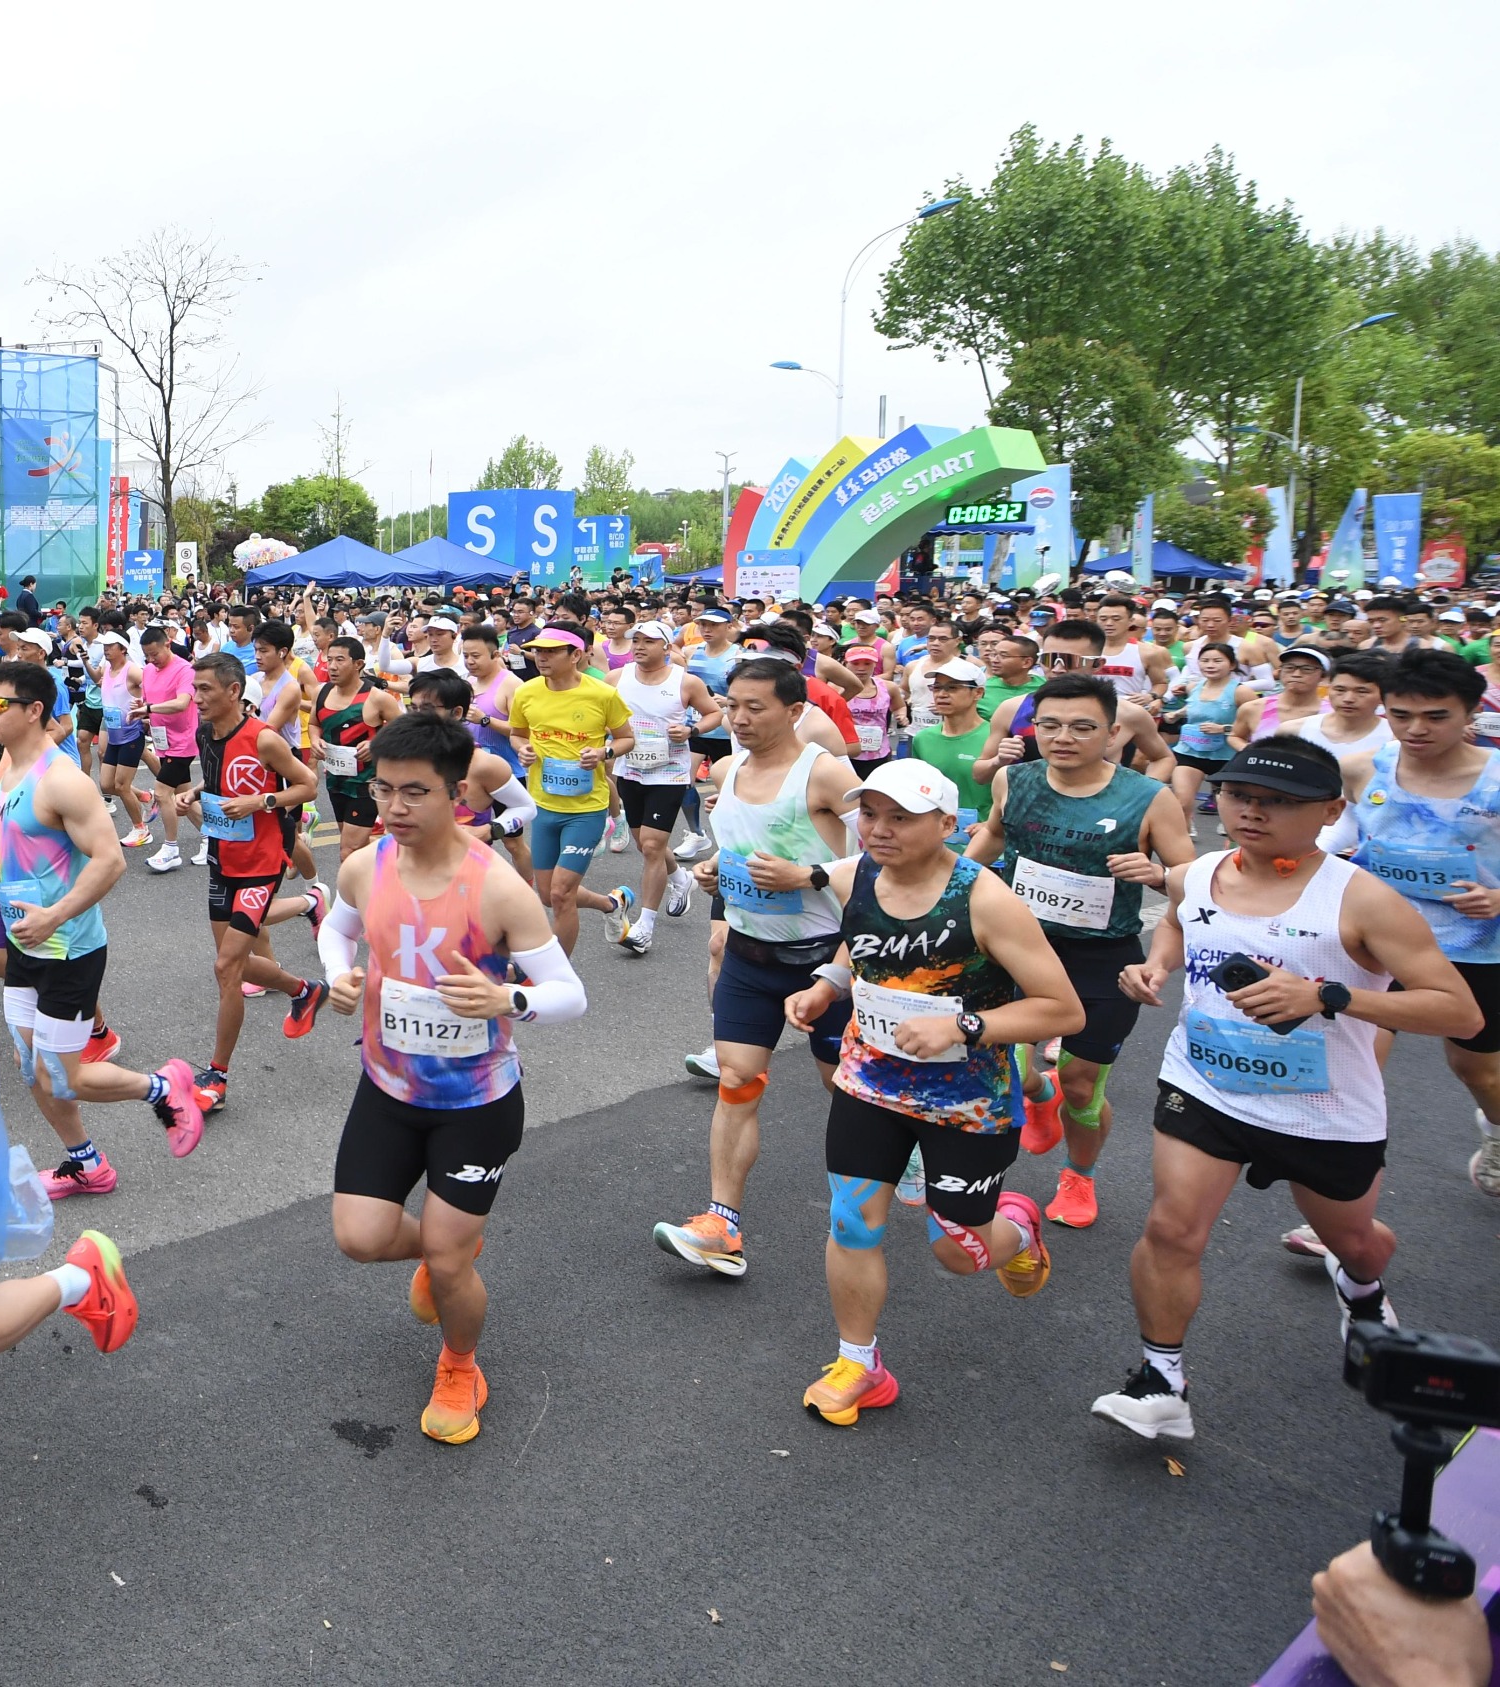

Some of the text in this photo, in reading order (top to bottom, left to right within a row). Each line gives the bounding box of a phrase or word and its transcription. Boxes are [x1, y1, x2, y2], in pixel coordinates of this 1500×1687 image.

[764, 471, 801, 513] 2026
[947, 502, 1023, 524] 0:00:32
[464, 504, 558, 557] S S
[183, 550, 191, 559] 5
[531, 561, 555, 575] 检录
[1258, 759, 1294, 770] ZEEKR
[542, 774, 579, 786] B51309
[203, 811, 236, 828] B50987
[719, 873, 776, 901] B51212
[1014, 881, 1085, 913] B10872
[384, 1012, 462, 1041] B11127
[1189, 1041, 1288, 1078] B50690
